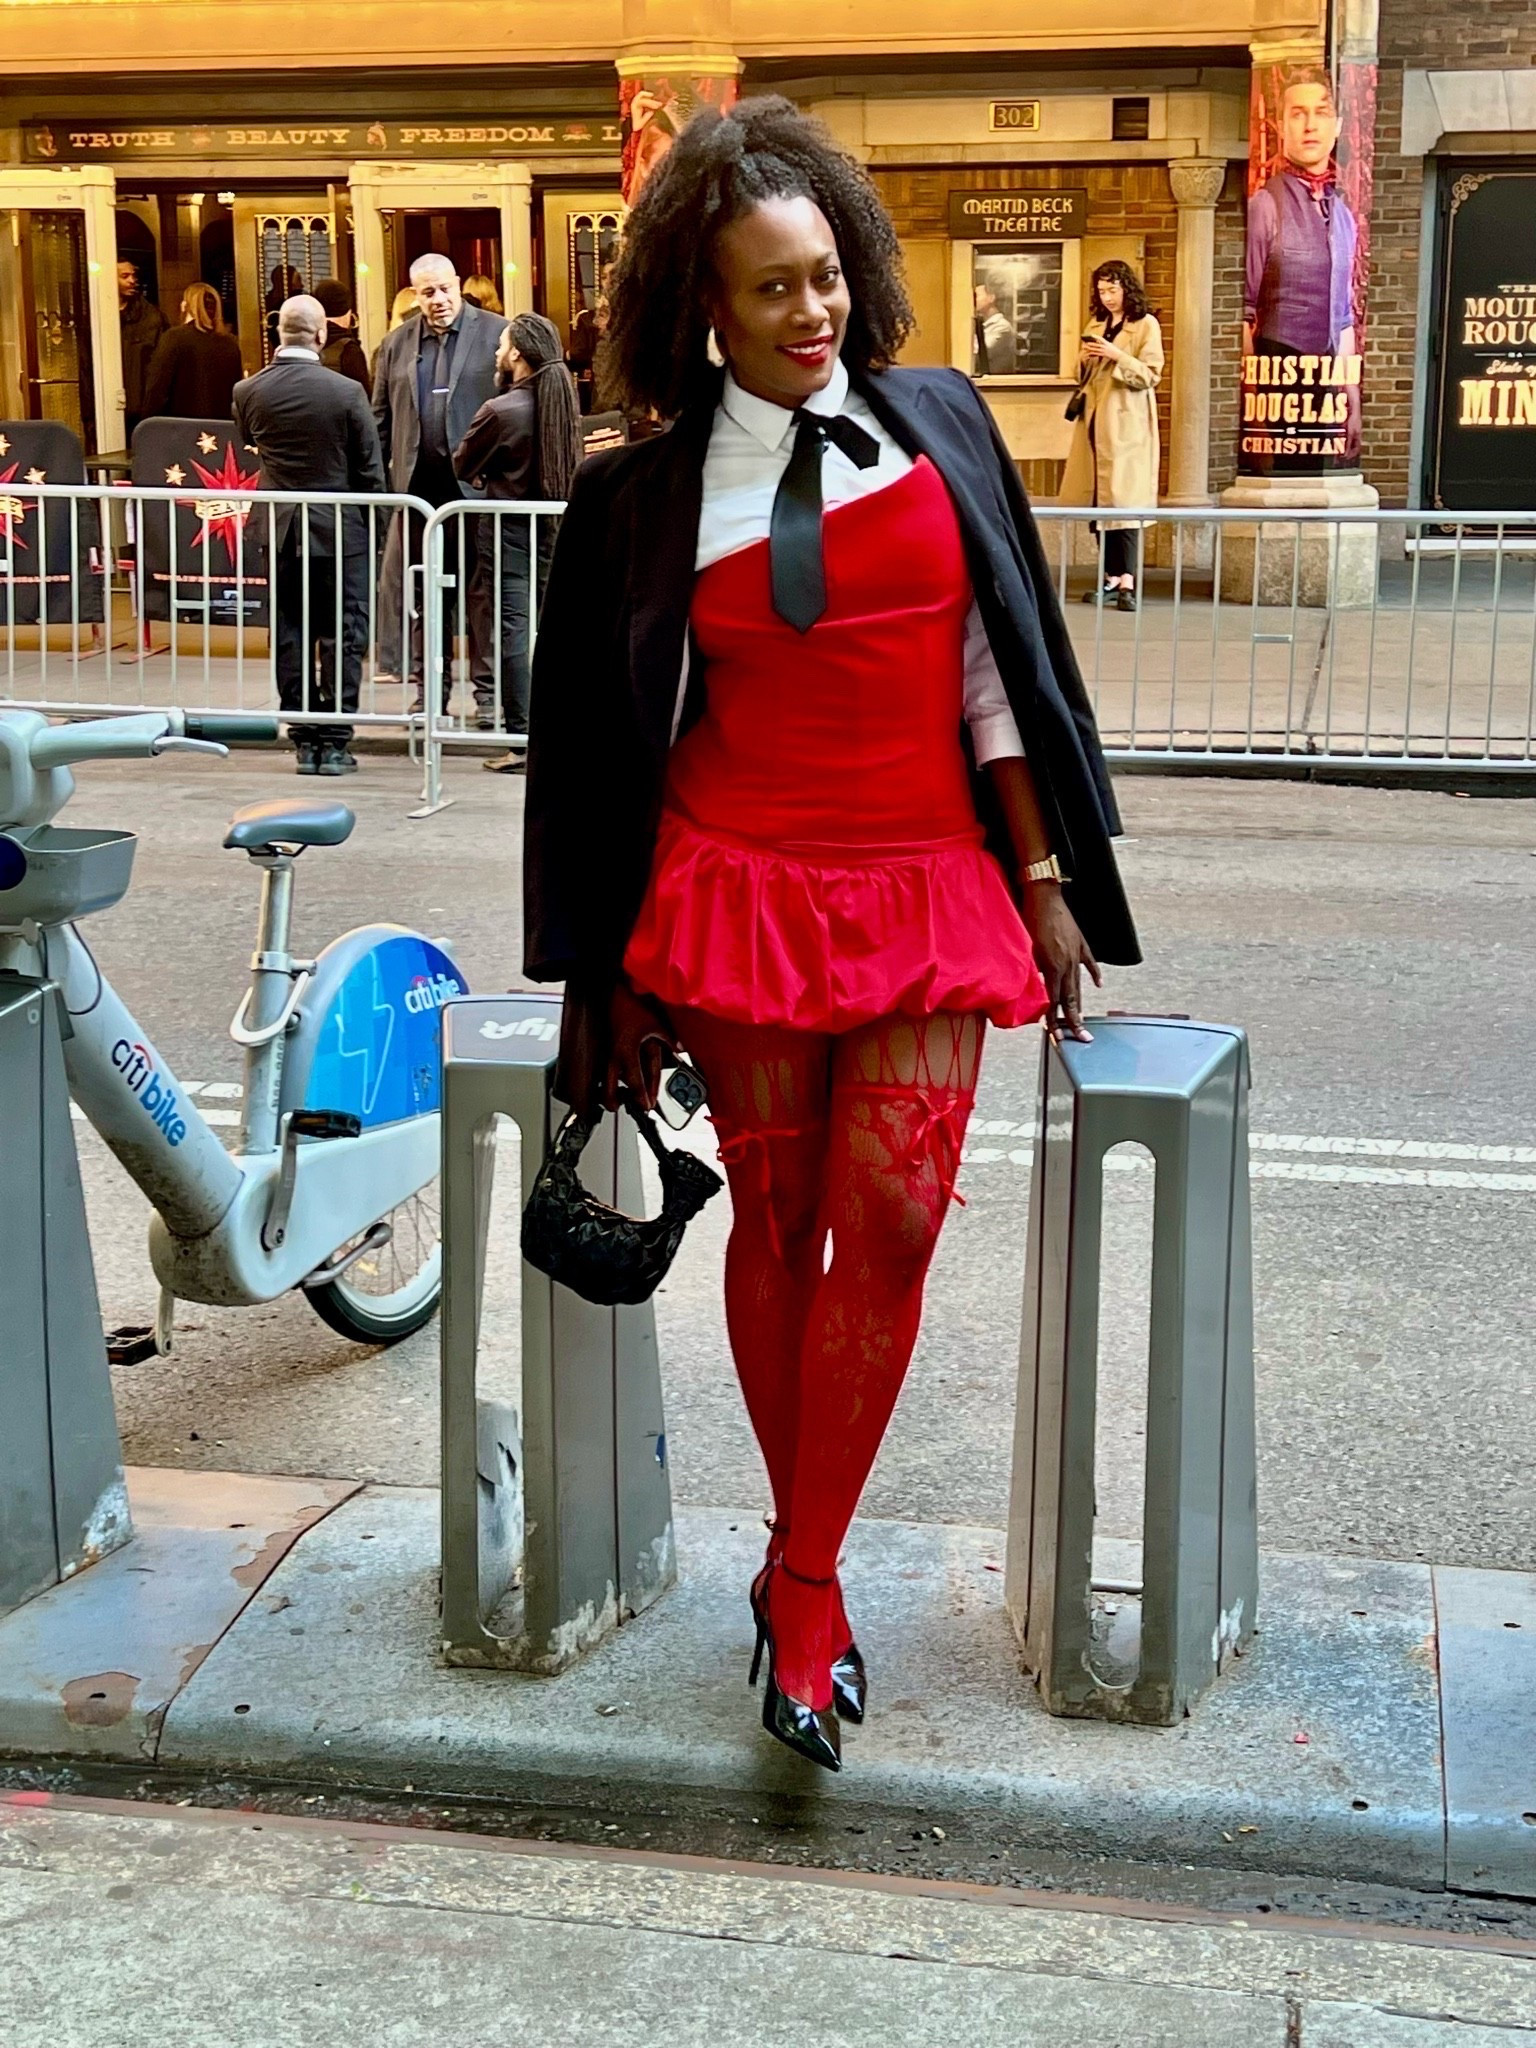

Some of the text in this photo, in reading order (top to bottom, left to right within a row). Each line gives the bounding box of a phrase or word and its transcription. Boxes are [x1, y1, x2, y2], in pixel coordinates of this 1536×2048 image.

[995, 107, 1034, 126] 302
[69, 132, 175, 147] TRUTH
[226, 129, 350, 145] BEAUTY
[400, 127, 555, 143] FREEDOM
[963, 198, 1073, 214] MARTIN BECK
[982, 217, 1062, 232] THEATRE
[1243, 392, 1348, 423] DOUGLAS
[1459, 379, 1536, 426] MIN
[1242, 437, 1346, 454] CHRISTIAN
[479, 1017, 559, 1042] lyft
